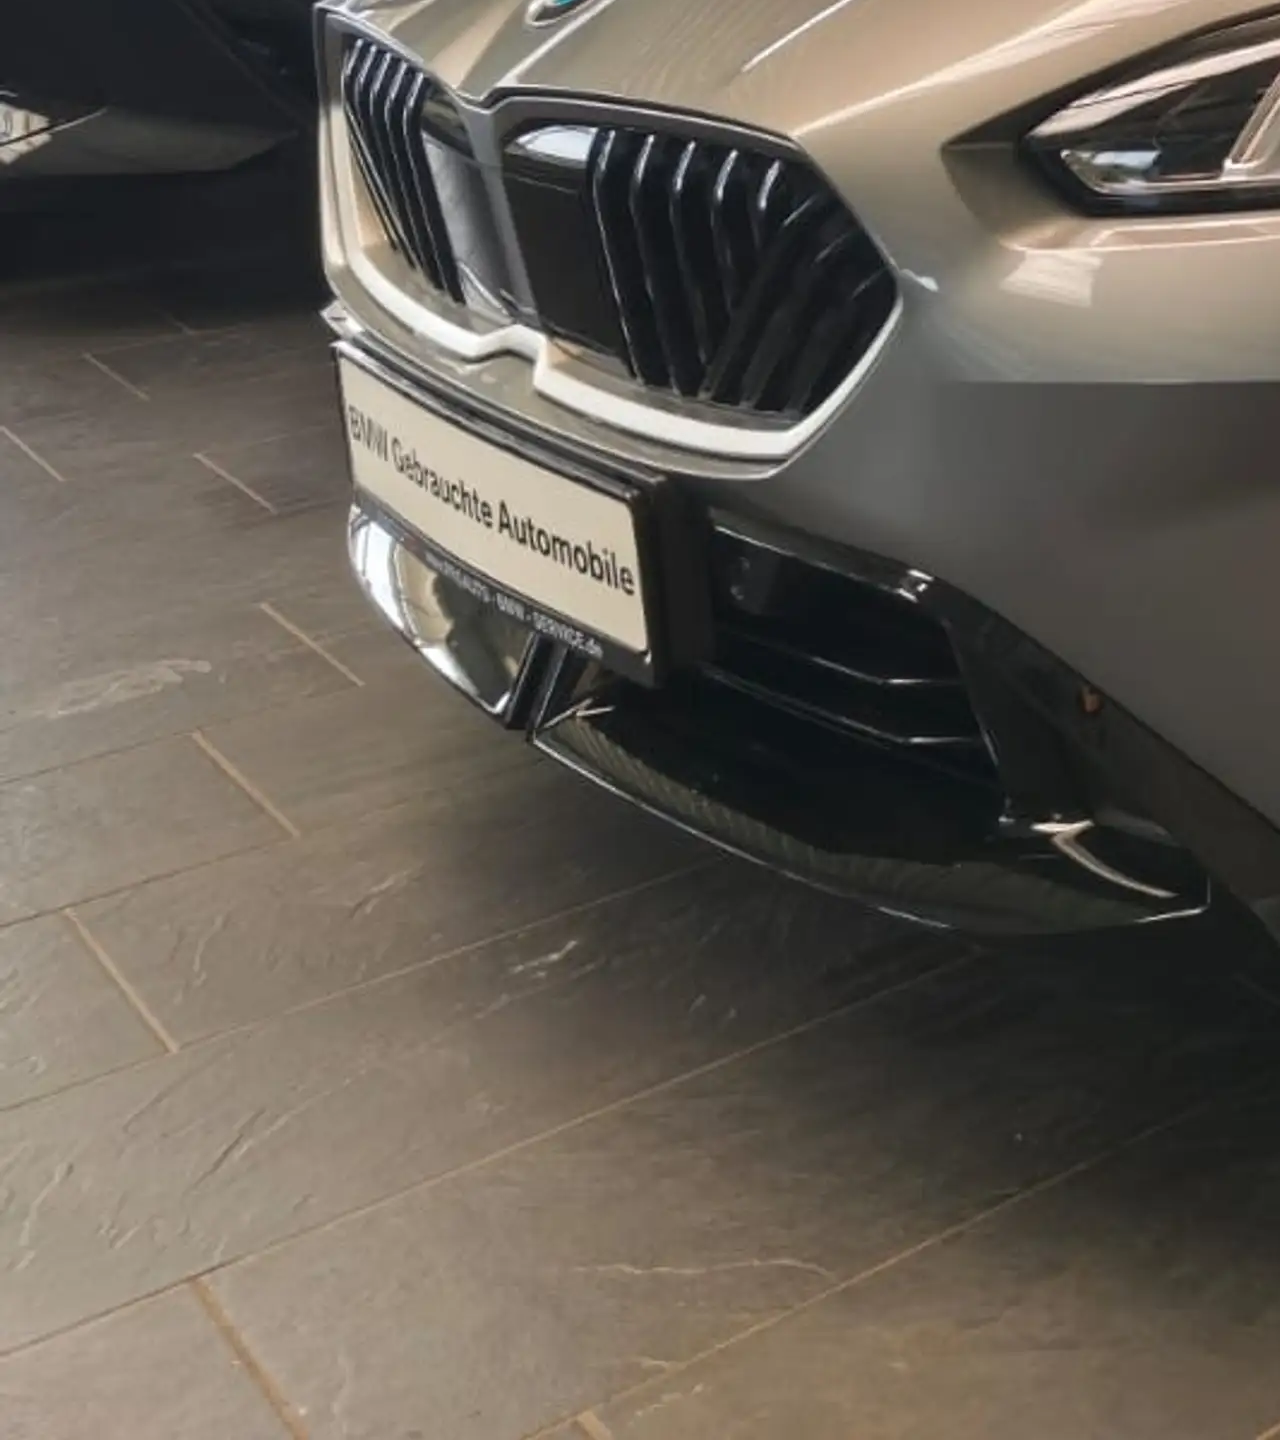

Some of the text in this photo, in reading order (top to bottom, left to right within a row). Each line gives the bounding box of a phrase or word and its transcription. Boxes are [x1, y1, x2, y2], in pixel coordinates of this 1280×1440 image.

[348, 404, 389, 462] BMW
[391, 436, 493, 529] Gebrauchte
[498, 499, 636, 596] Automobile
